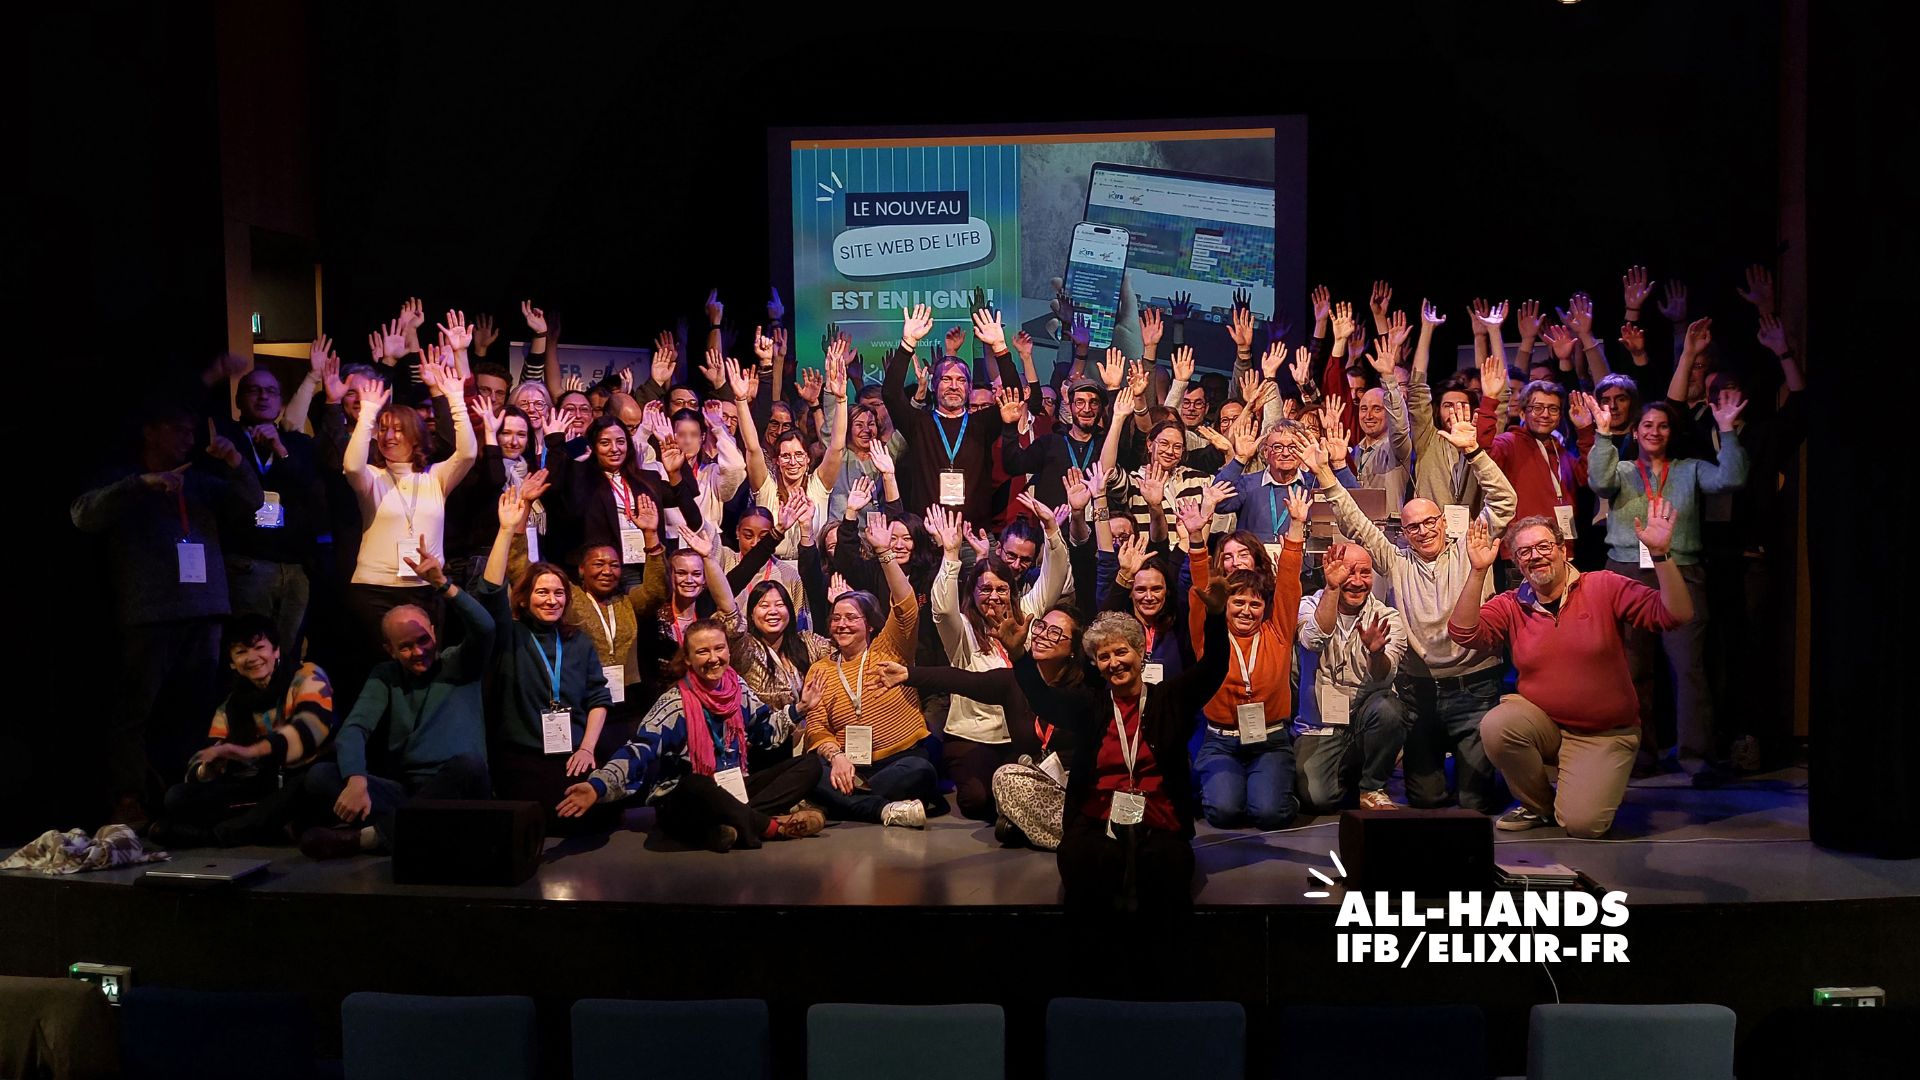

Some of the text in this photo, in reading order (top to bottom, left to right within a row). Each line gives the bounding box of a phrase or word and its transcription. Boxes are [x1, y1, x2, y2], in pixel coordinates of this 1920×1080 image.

[853, 200, 961, 217] LE NOUVEAU
[840, 230, 981, 260] SITE WEB DE L'IFB
[831, 290, 873, 310] EST
[878, 290, 908, 309] EN
